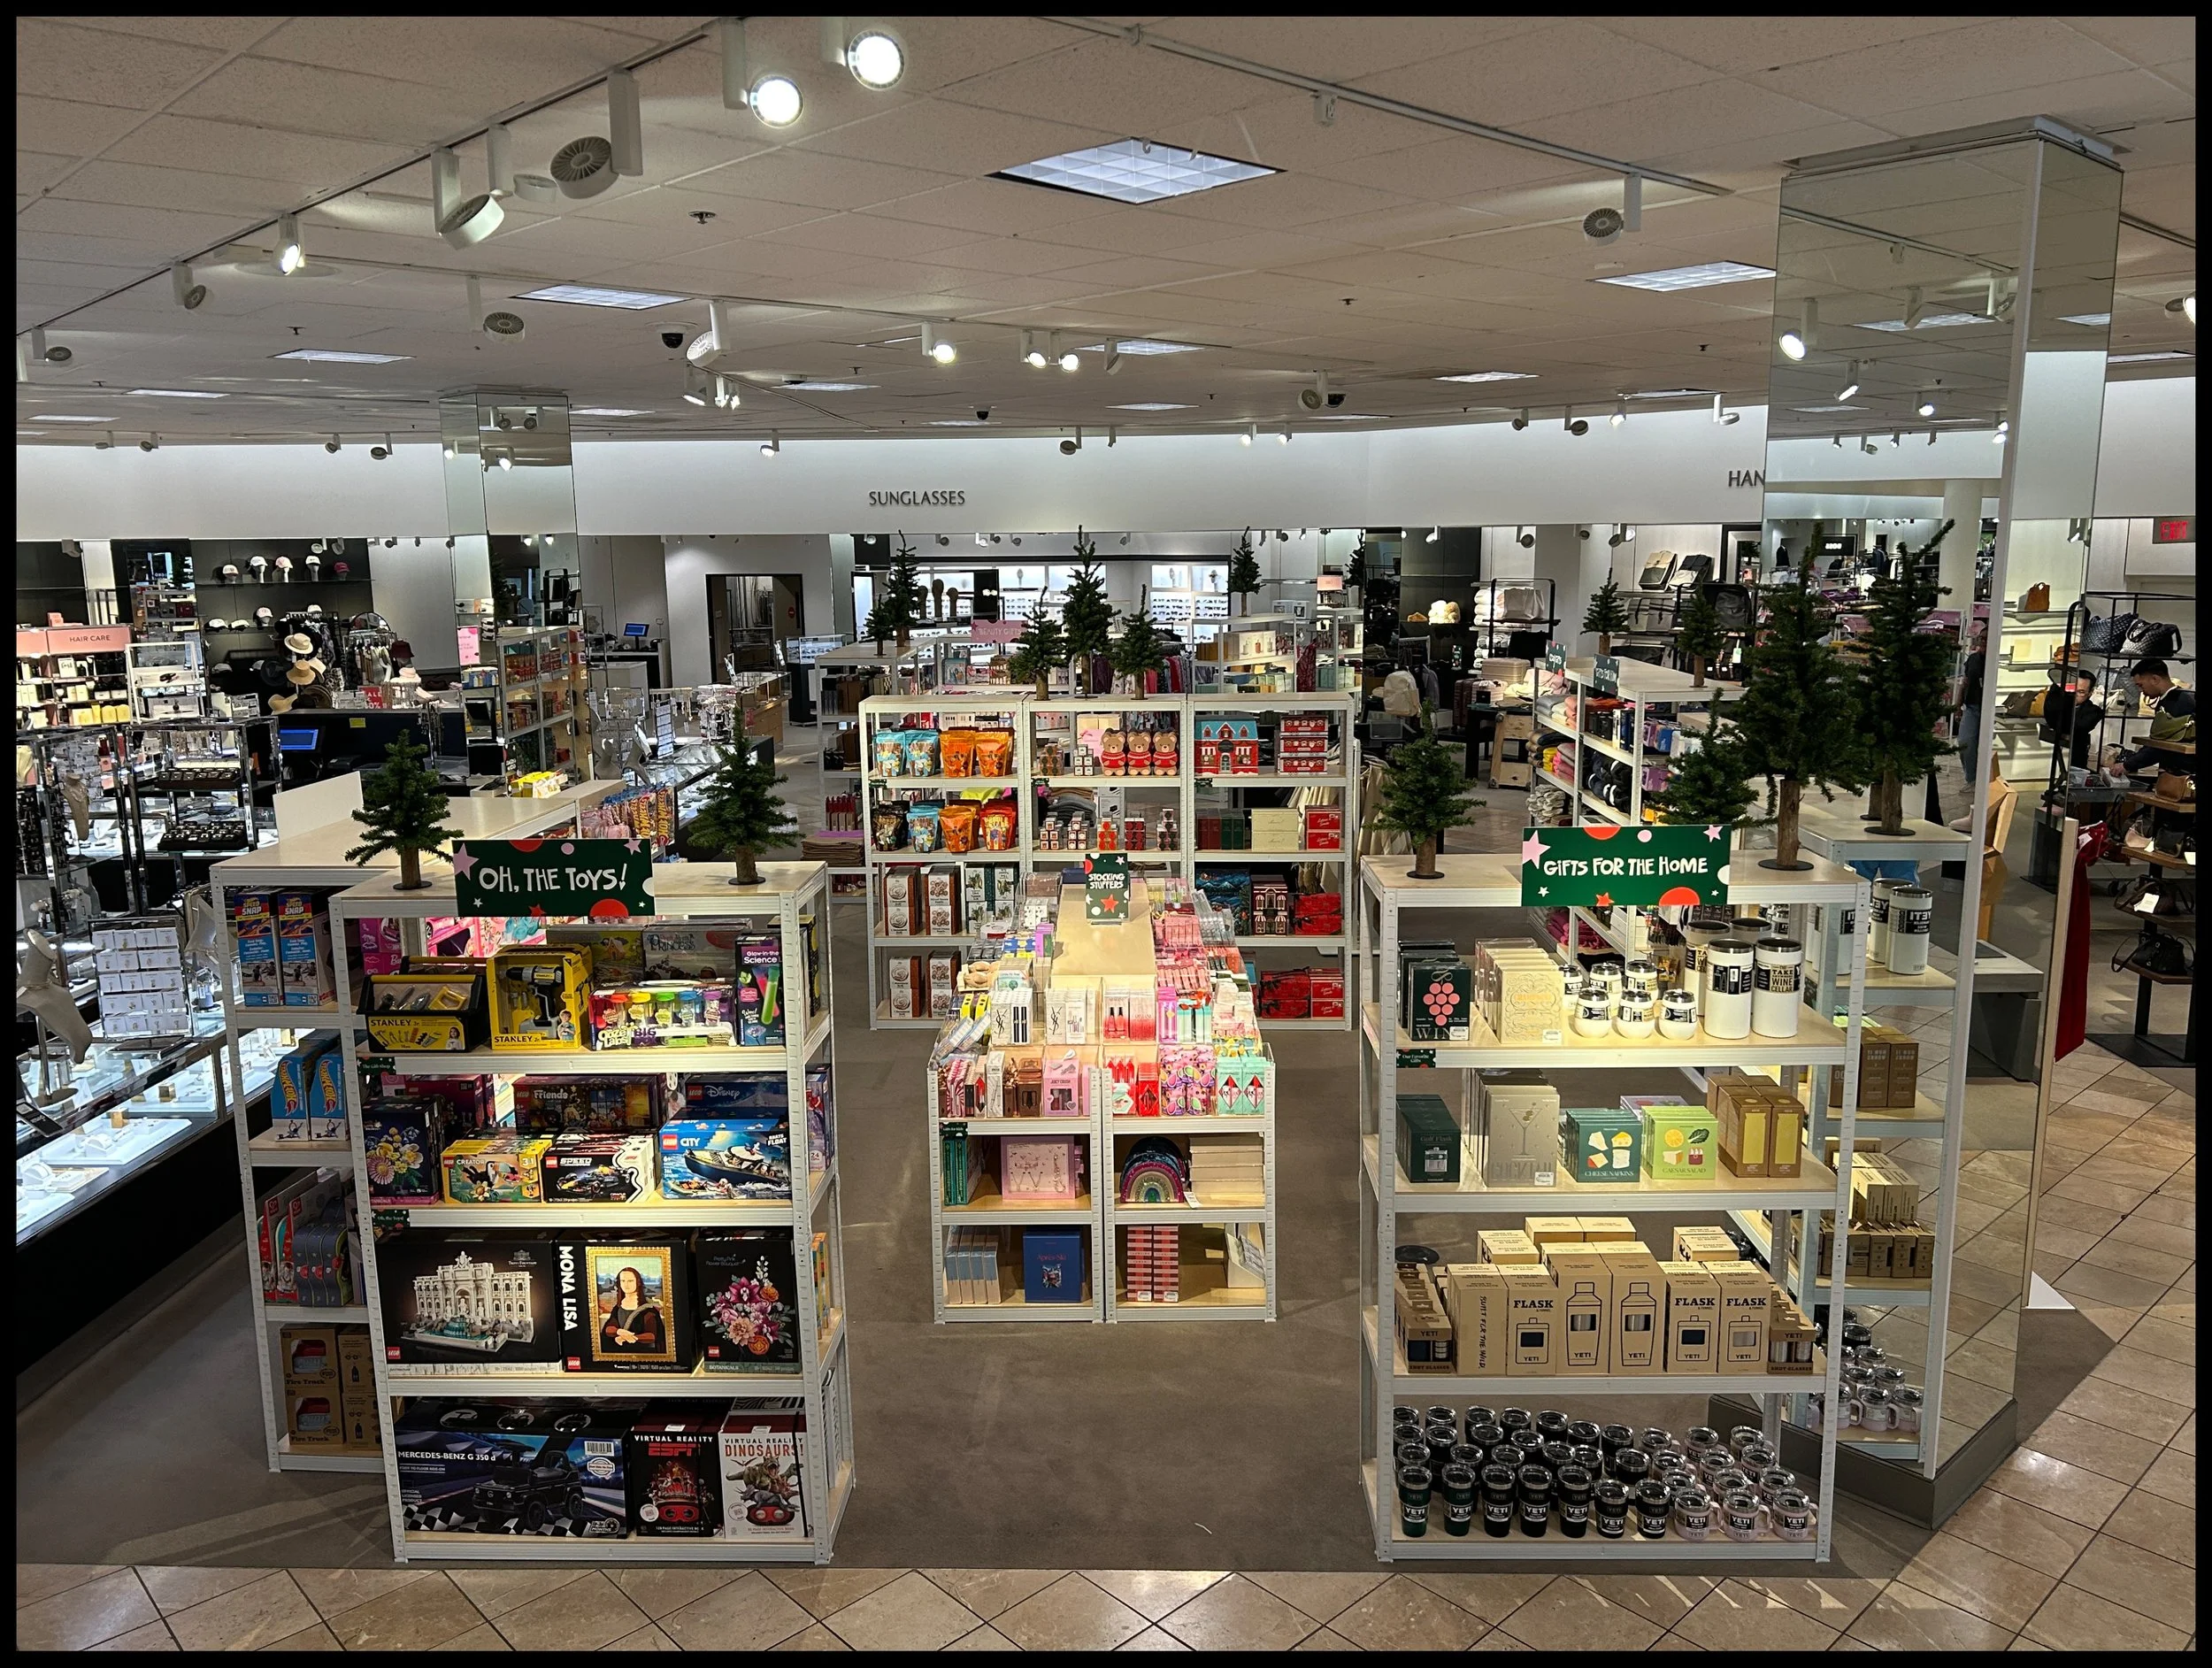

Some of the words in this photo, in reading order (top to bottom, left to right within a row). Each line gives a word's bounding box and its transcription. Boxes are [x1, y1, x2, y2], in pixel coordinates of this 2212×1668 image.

[868, 490, 965, 505] SUNGLASSES
[1543, 859, 1588, 876] GIFTS
[1593, 857, 1624, 876] FOR
[1628, 857, 1655, 876] THE
[1658, 856, 1709, 876] HOME
[479, 865, 519, 893] OH,
[524, 867, 560, 892] THE
[565, 863, 627, 891] TOYS!
[242, 906, 262, 915] SNAP
[285, 906, 304, 915] SNAP
[1771, 978, 1793, 987] WINE
[597, 1027, 626, 1040] Ooze
[634, 1027, 657, 1036] BIG
[1416, 1027, 1451, 1039] WIN
[534, 1088, 568, 1099] Friends
[680, 1137, 701, 1147] CITY
[559, 1246, 576, 1294] MONA
[1675, 1297, 1716, 1306] FLASK
[1726, 1297, 1767, 1306] FLASK
[563, 1298, 578, 1331] LISA
[398, 1451, 465, 1460] MERCEDES-BENZ
[725, 1444, 804, 1457] DINOSAURS!
[1741, 1466, 1756, 1477] YETI
